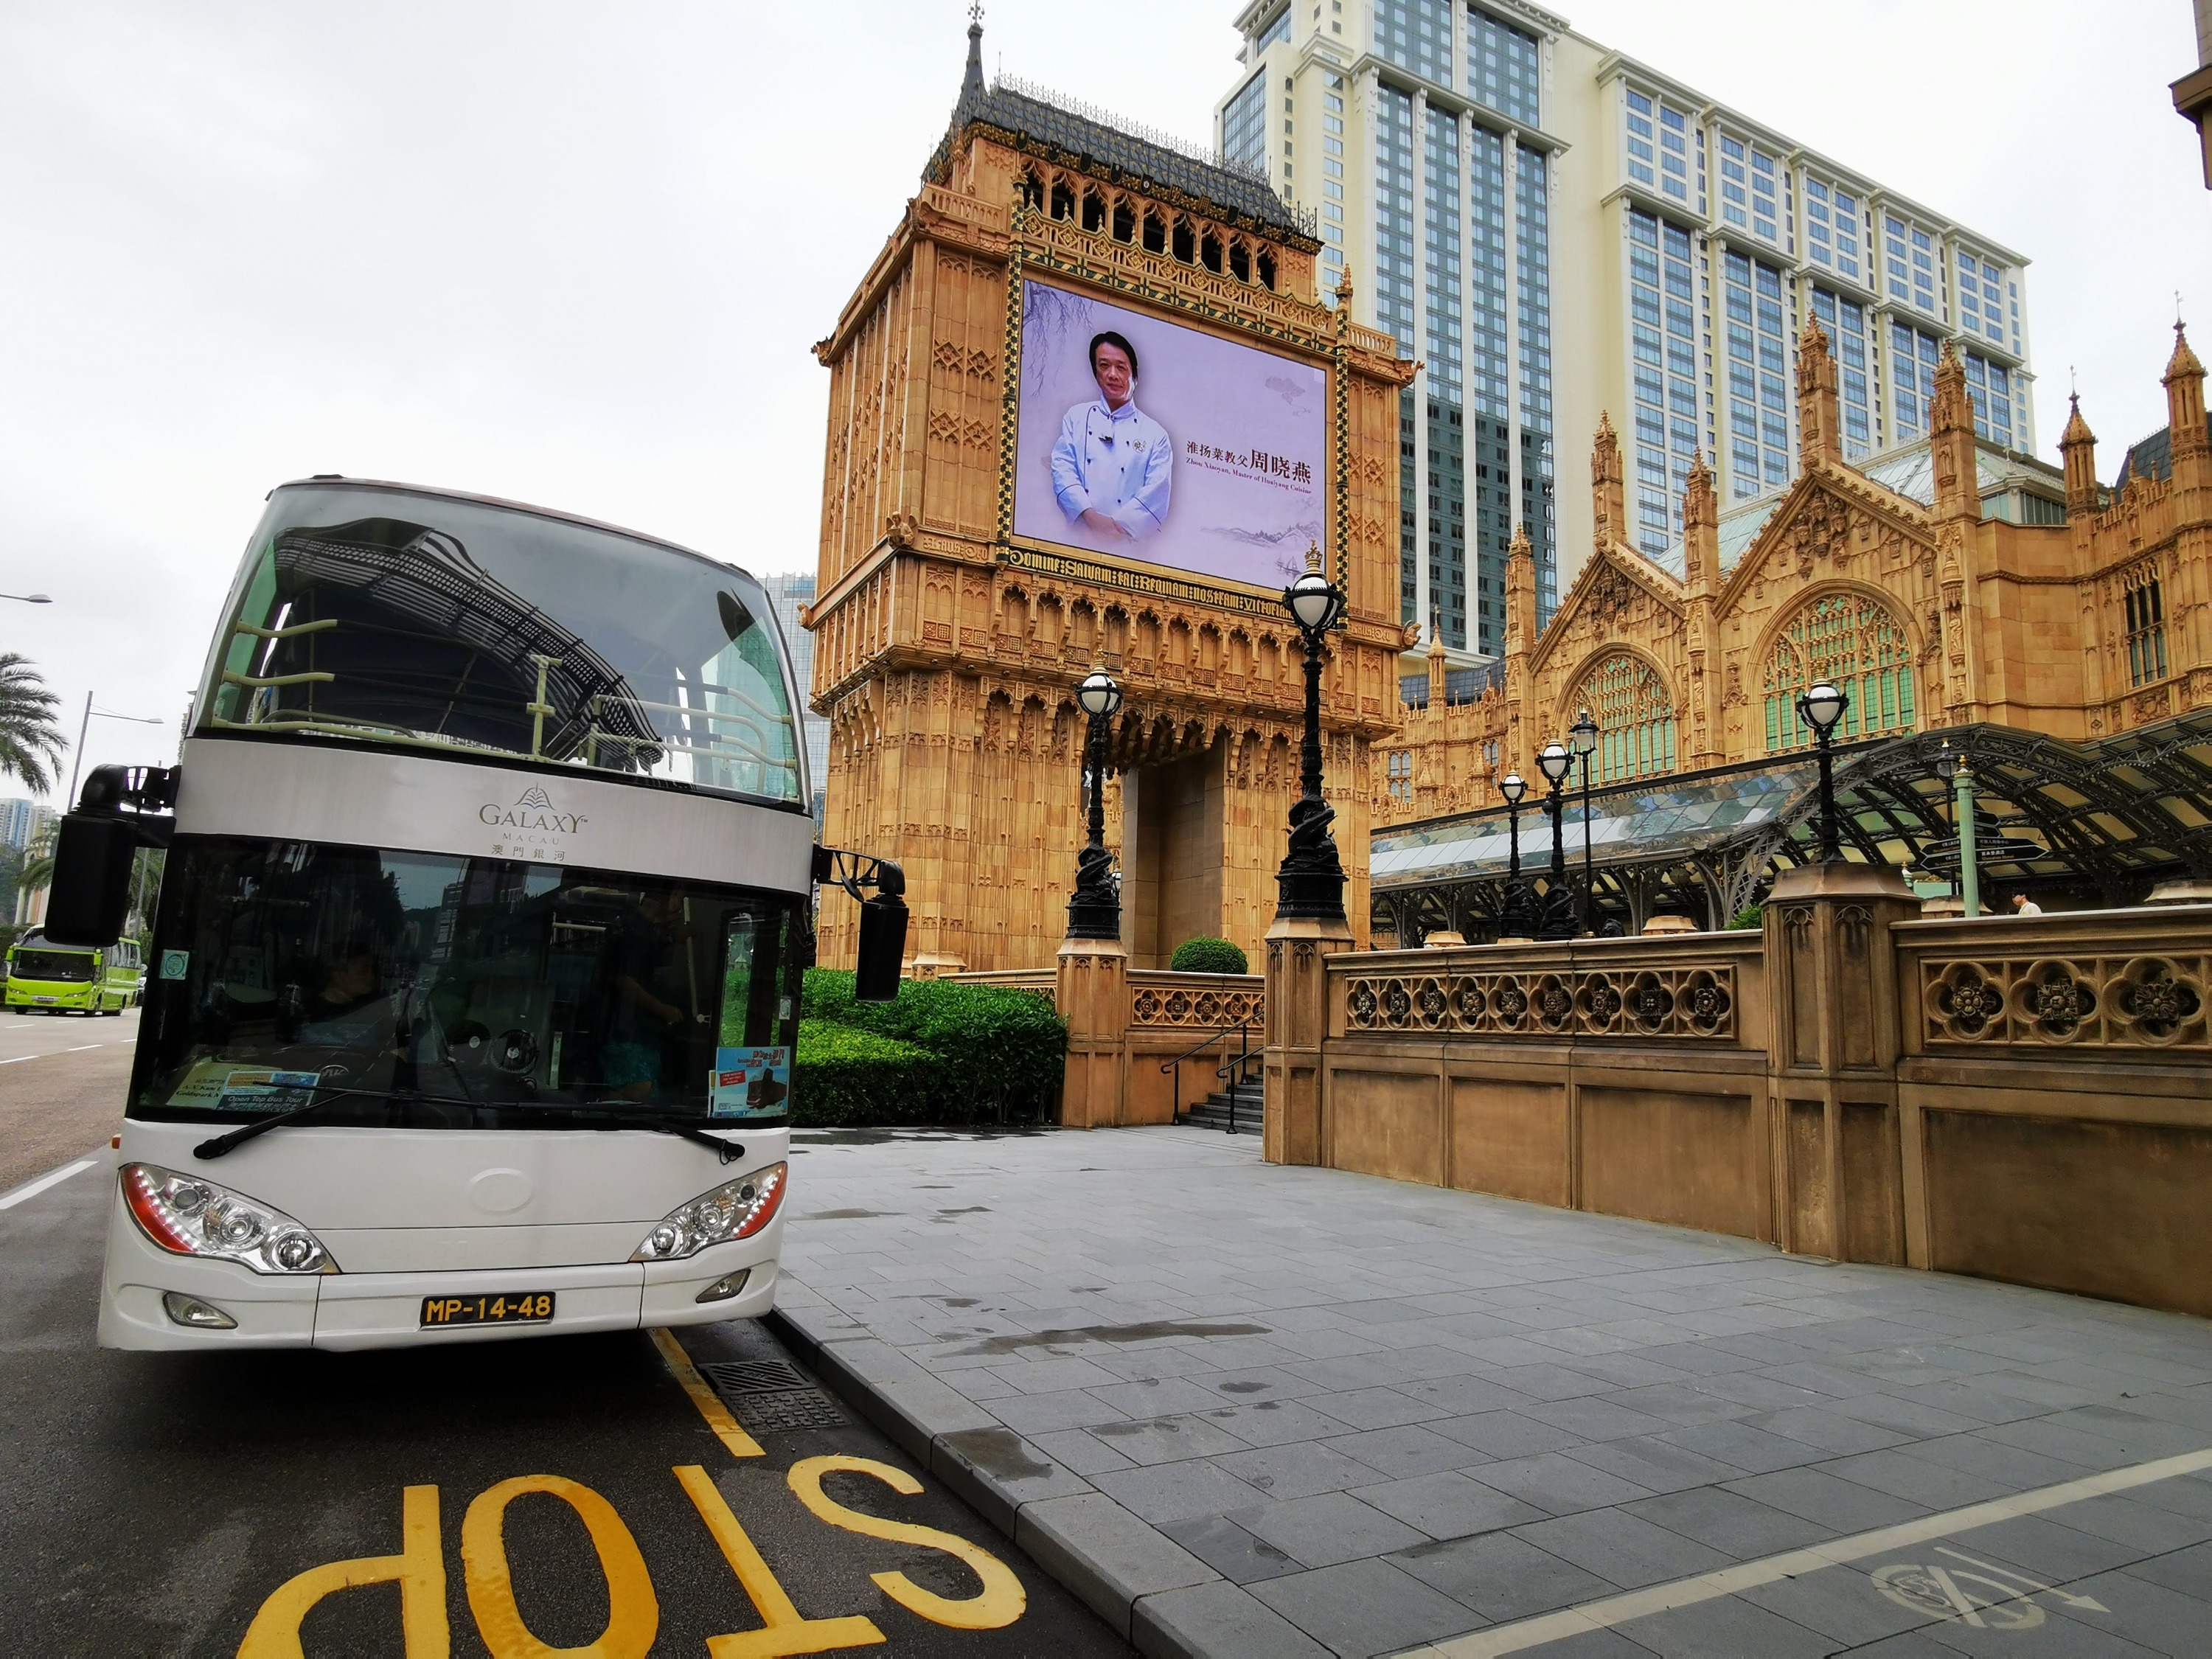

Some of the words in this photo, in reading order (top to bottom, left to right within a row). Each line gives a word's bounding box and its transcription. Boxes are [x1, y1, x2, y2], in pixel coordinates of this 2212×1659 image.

[1186, 456, 1203, 467] Zhou
[1233, 468, 1253, 480] Master
[1262, 476, 1289, 490] Huaiyang
[1290, 484, 1312, 495] Cuisine
[479, 804, 587, 834] GALAXY
[491, 844, 566, 862] 澳門銀河
[502, 832, 560, 845] MACAU
[425, 1295, 552, 1323] MP-14-48
[235, 1455, 1027, 1659] STOP
